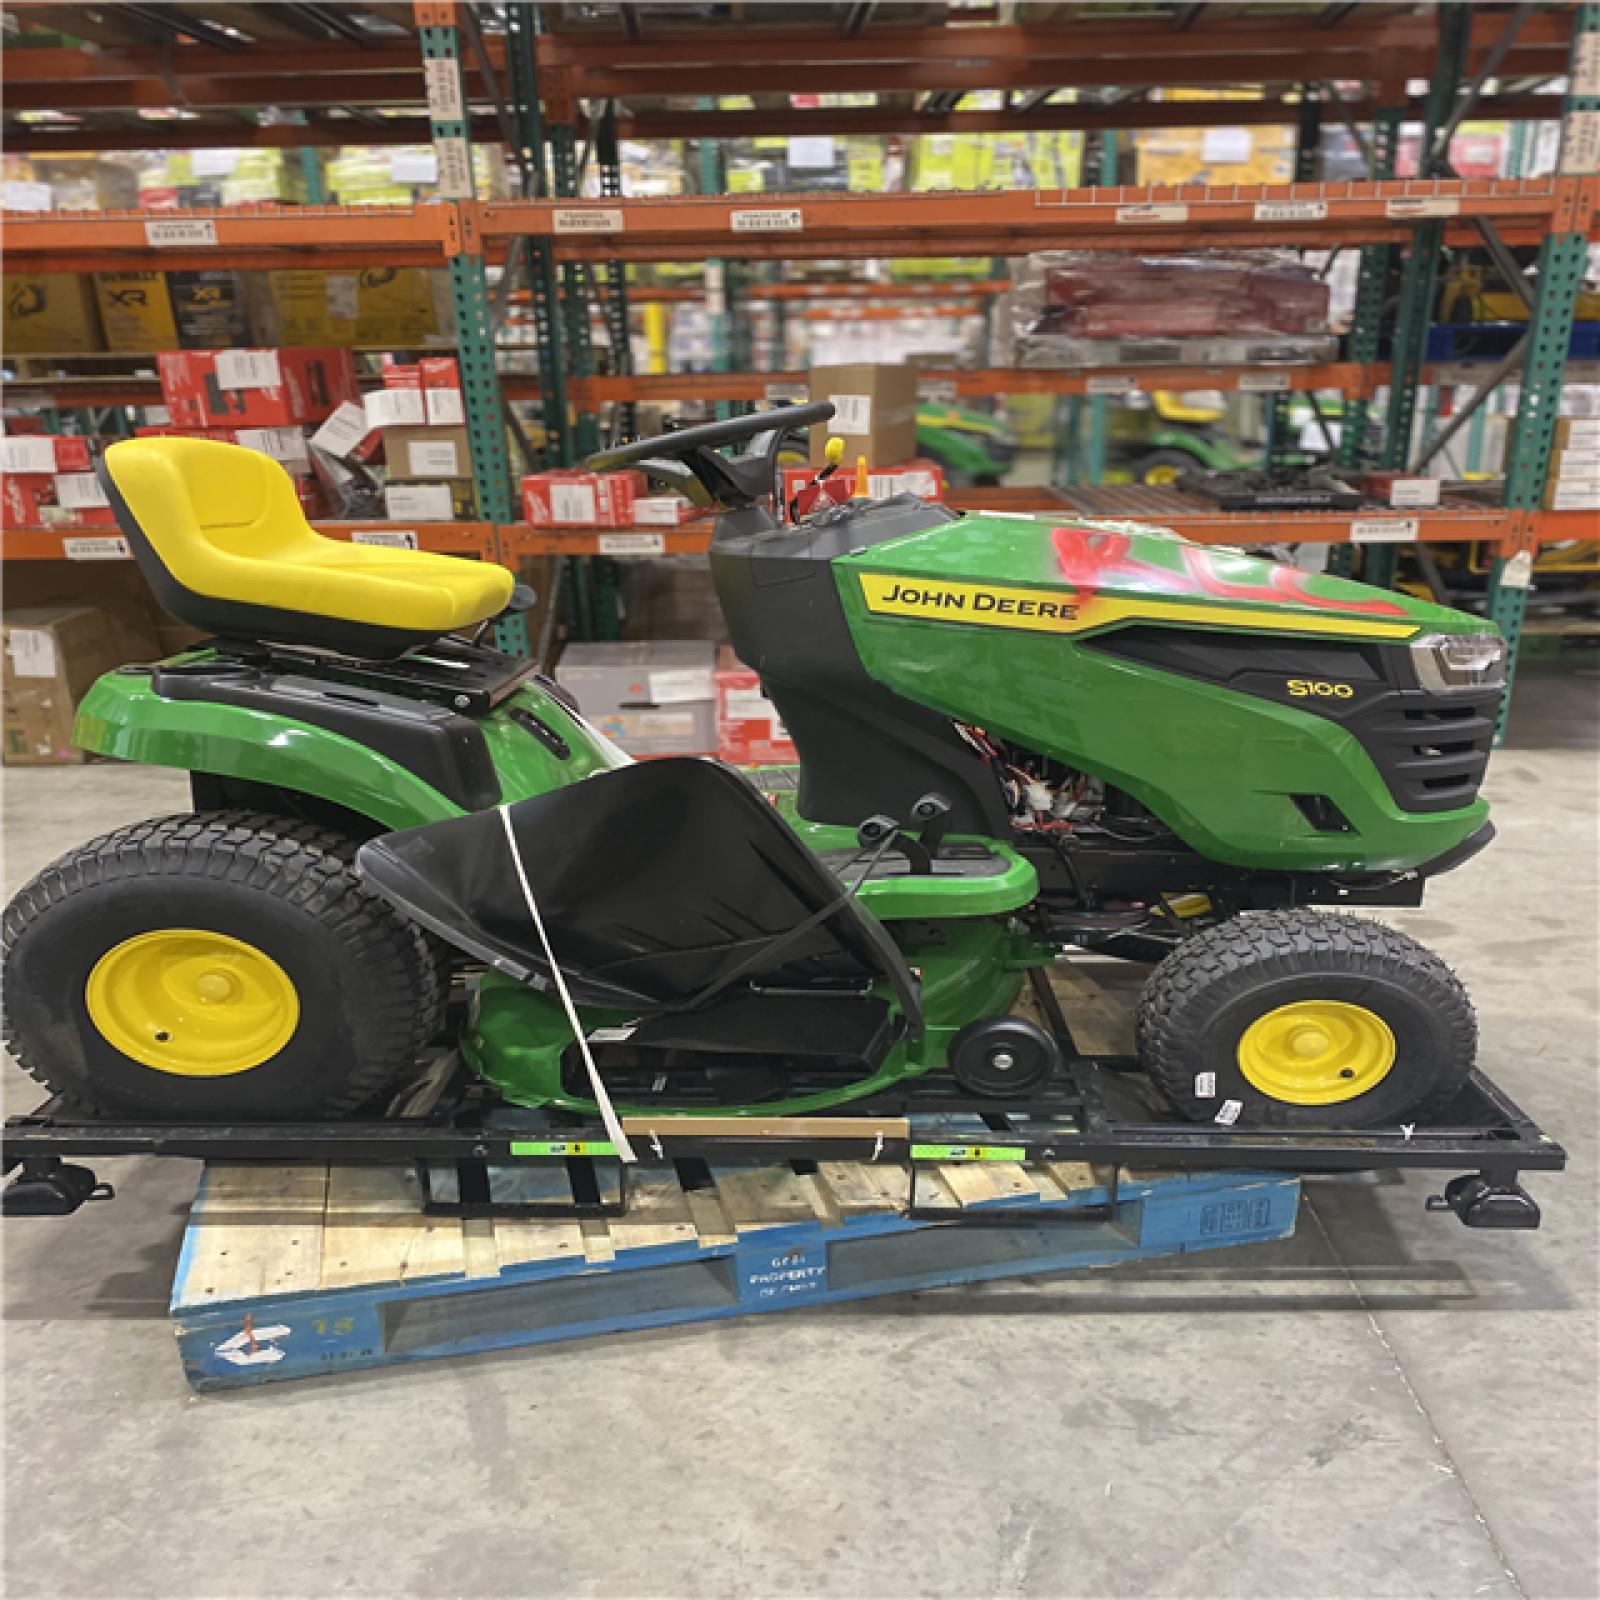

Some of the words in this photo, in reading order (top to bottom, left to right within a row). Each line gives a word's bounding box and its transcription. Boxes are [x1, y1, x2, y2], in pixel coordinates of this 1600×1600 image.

[882, 585, 965, 609] JOHN
[972, 592, 1081, 621] DEERE
[1287, 679, 1354, 699] S100
